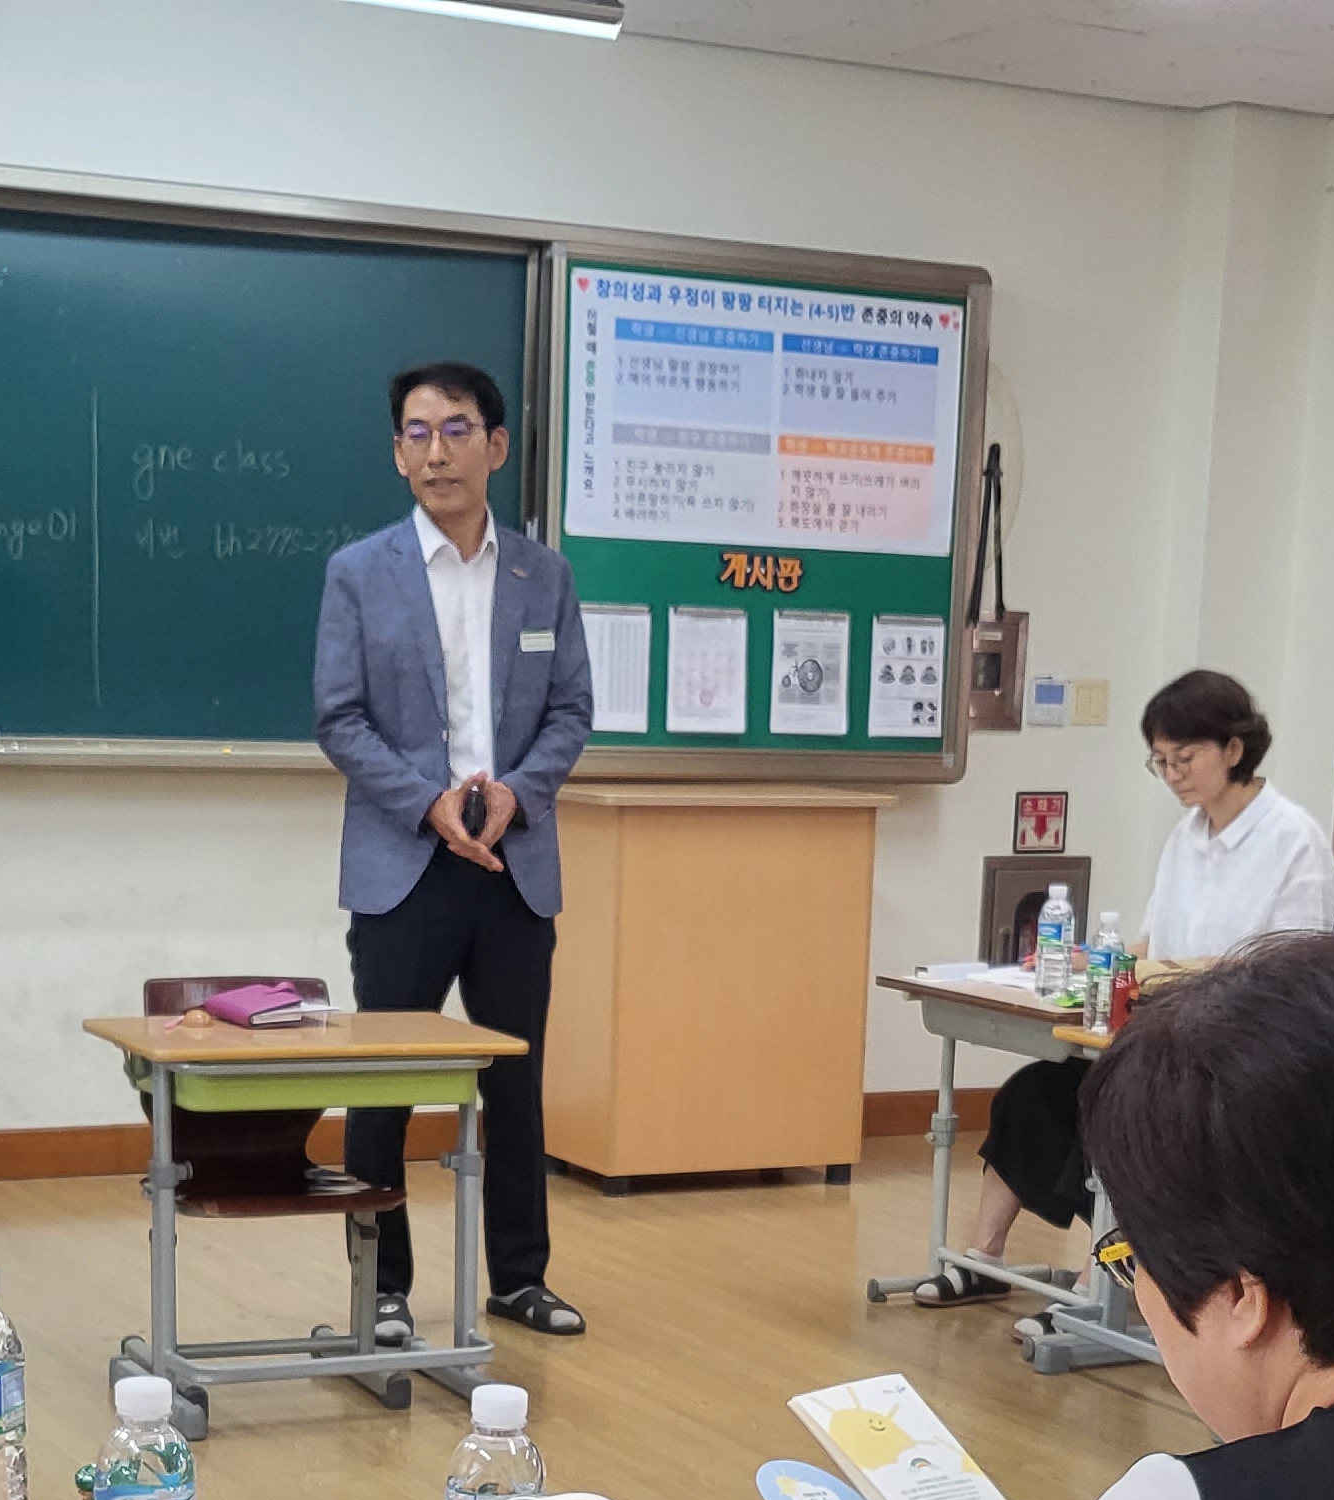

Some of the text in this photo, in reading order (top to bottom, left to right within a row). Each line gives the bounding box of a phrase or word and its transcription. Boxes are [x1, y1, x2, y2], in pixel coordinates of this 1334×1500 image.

[596, 278, 662, 304] 창의성과
[667, 285, 717, 310] 우정이
[721, 291, 753, 312] 팡팡
[757, 295, 804, 318] 터지는
[860, 306, 903, 328] 존중의
[906, 311, 934, 331] 약속
[718, 552, 803, 592] 게시판
